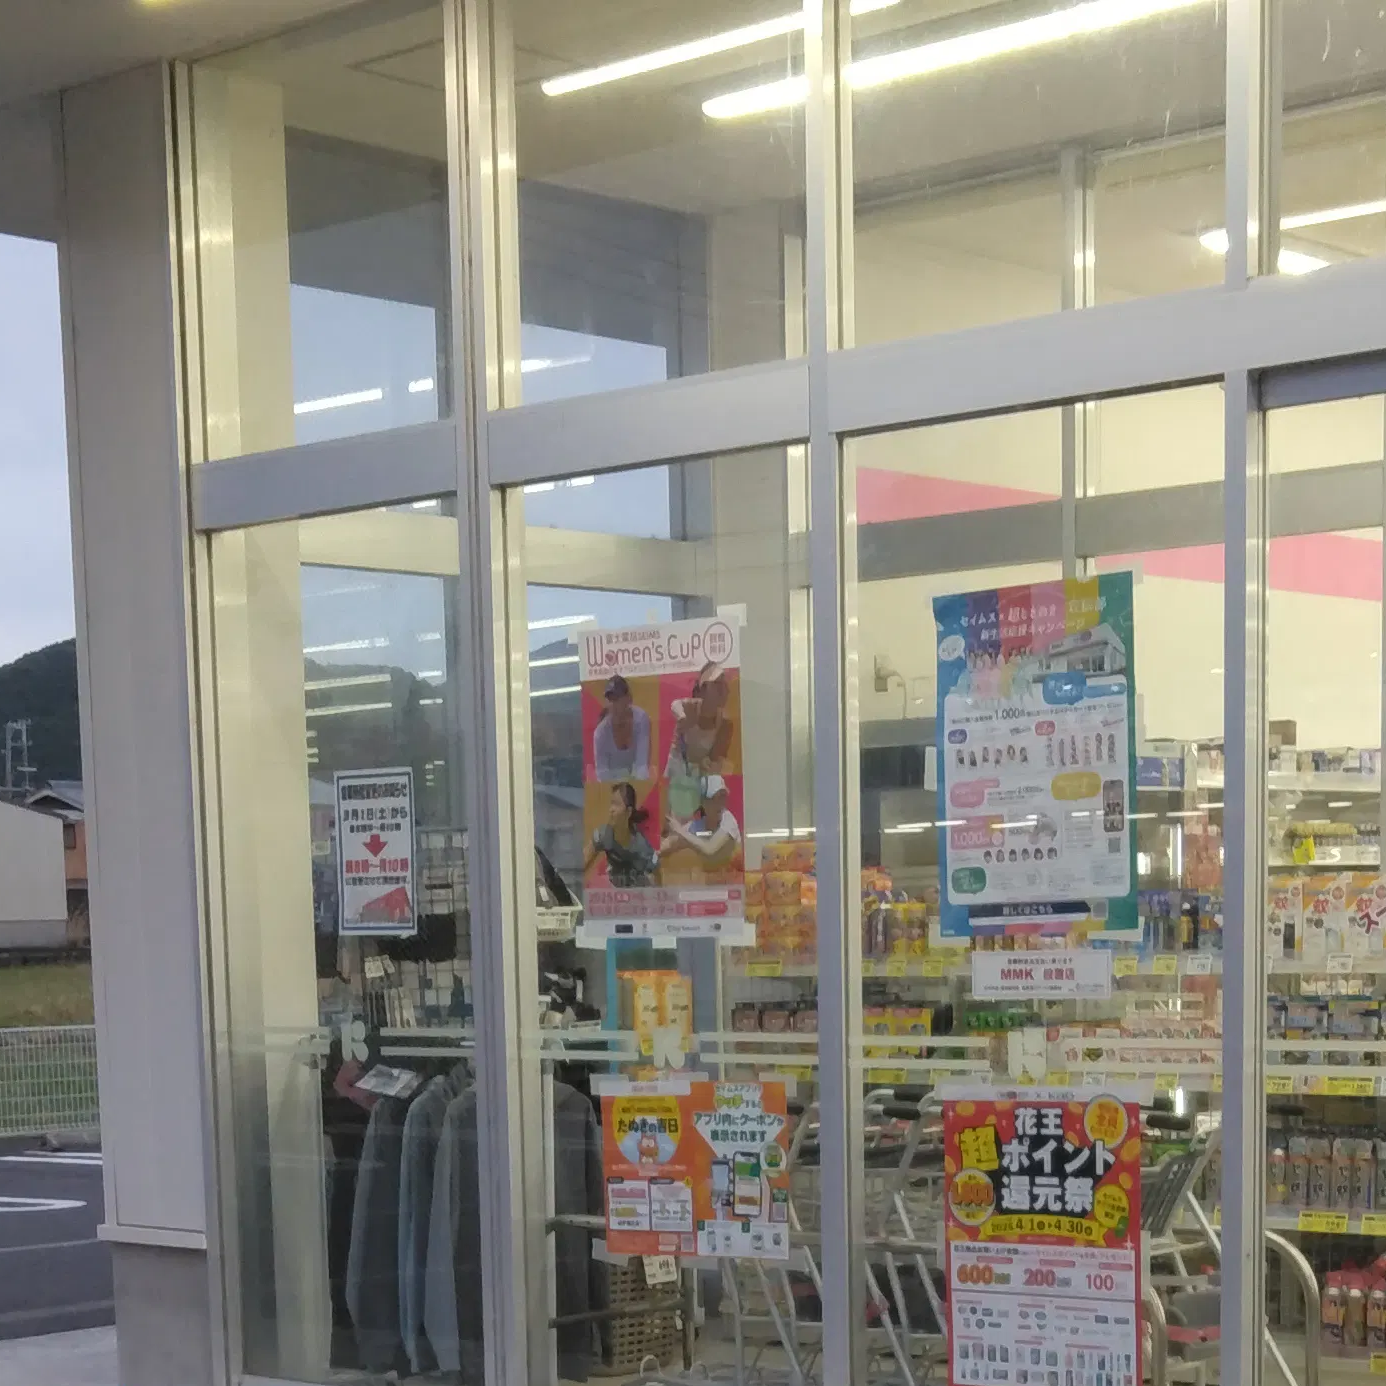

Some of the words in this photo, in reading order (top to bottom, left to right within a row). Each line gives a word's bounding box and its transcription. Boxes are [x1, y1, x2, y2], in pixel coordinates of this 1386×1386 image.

[586, 634, 663, 667] Women's
[1000, 968, 1034, 981] MMK
[616, 1117, 679, 1134] たぬきの吉日
[1014, 1107, 1064, 1136] 花王
[710, 1129, 767, 1143] 表示されます
[1001, 1137, 1116, 1176] ポイント
[1001, 1174, 1095, 1213] 還元祭
[956, 1263, 994, 1285] 600
[1023, 1268, 1056, 1288] 200
[1085, 1273, 1115, 1292] 100
